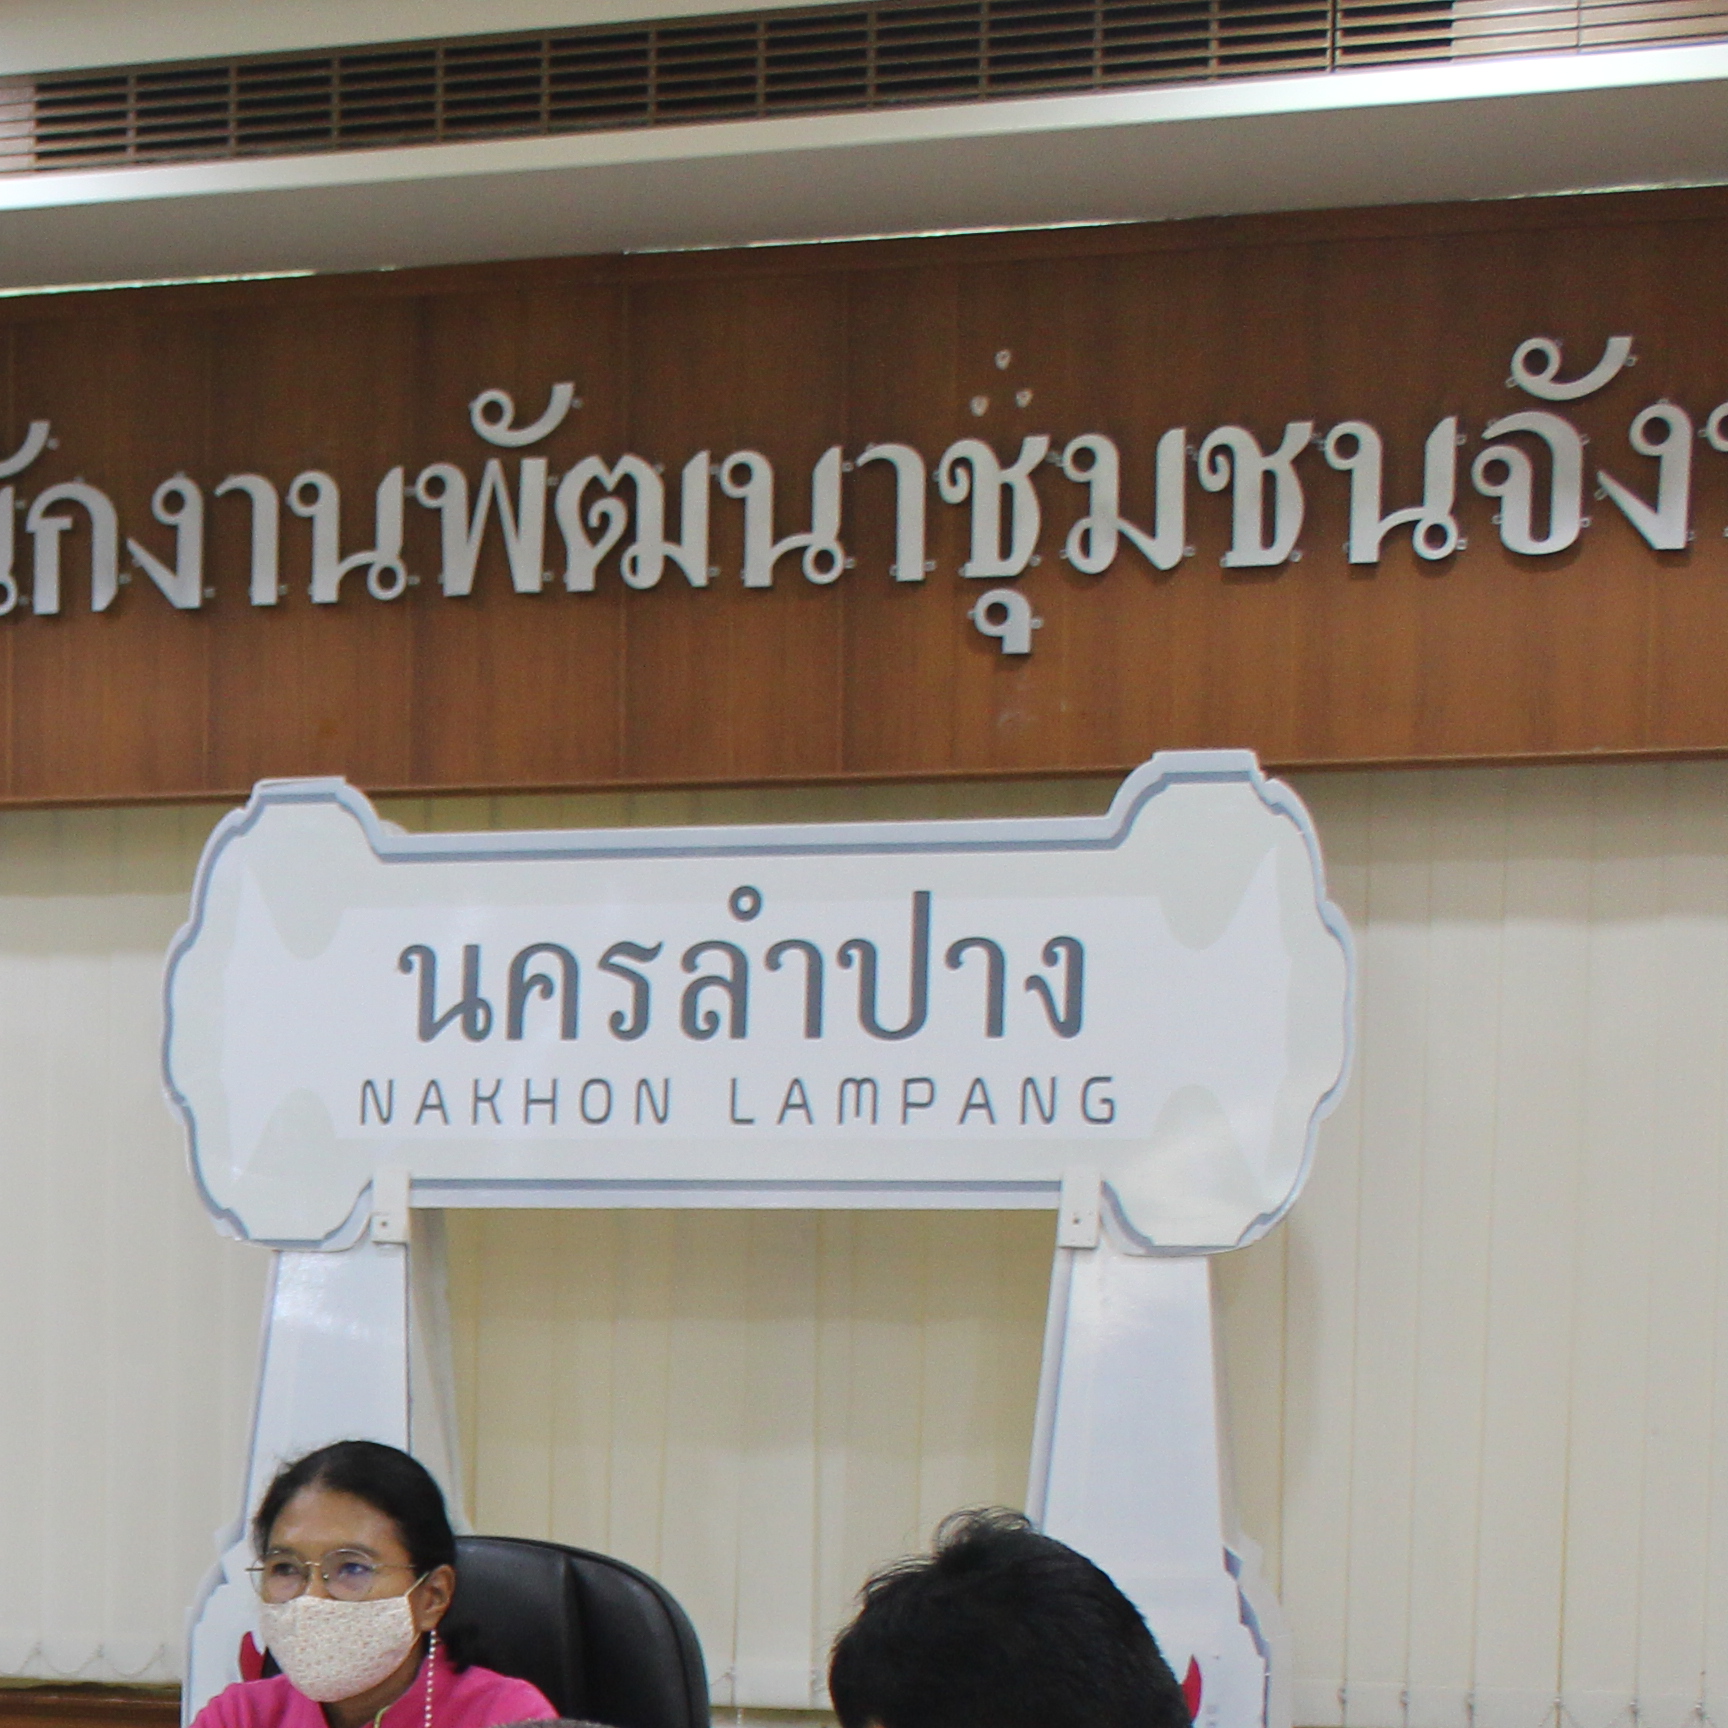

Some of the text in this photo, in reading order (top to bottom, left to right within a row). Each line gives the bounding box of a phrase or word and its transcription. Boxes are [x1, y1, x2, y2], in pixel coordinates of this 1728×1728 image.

[397, 884, 1085, 1043] นครลำปาง
[359, 1074, 1119, 1127] NAKHON LAMPANG
